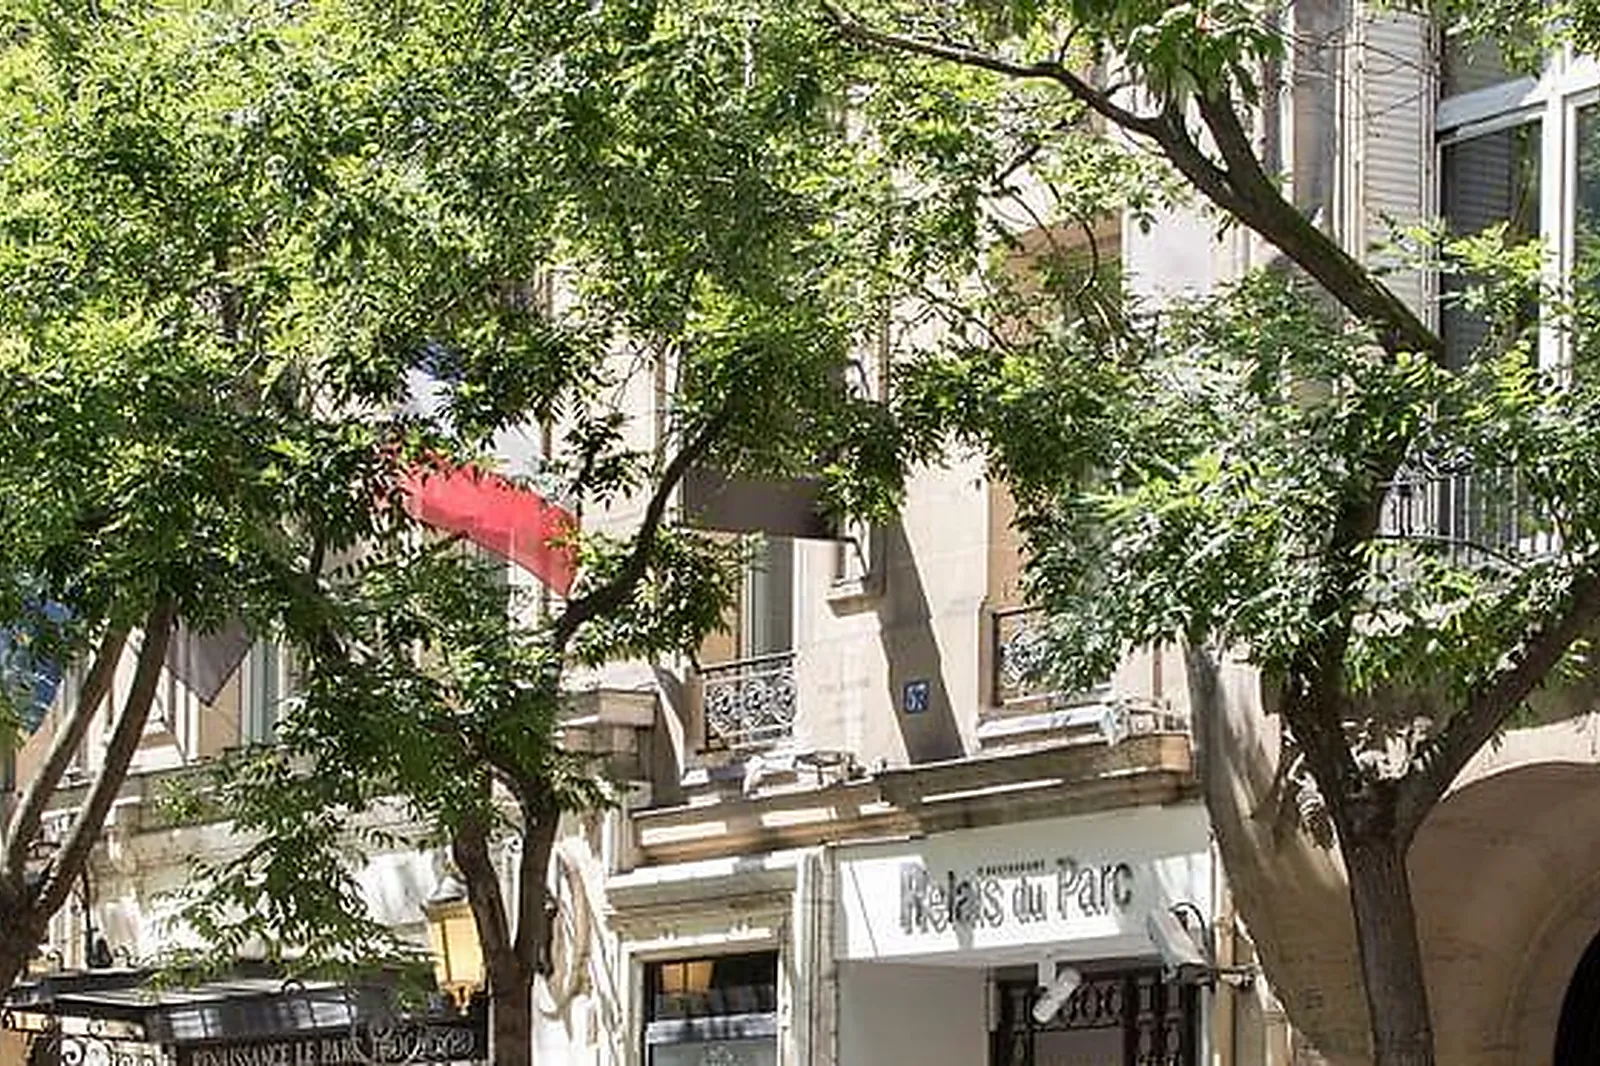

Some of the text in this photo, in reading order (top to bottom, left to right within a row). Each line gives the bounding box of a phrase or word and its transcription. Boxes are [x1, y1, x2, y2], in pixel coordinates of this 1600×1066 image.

[900, 858, 1133, 935] Relais du Parc
